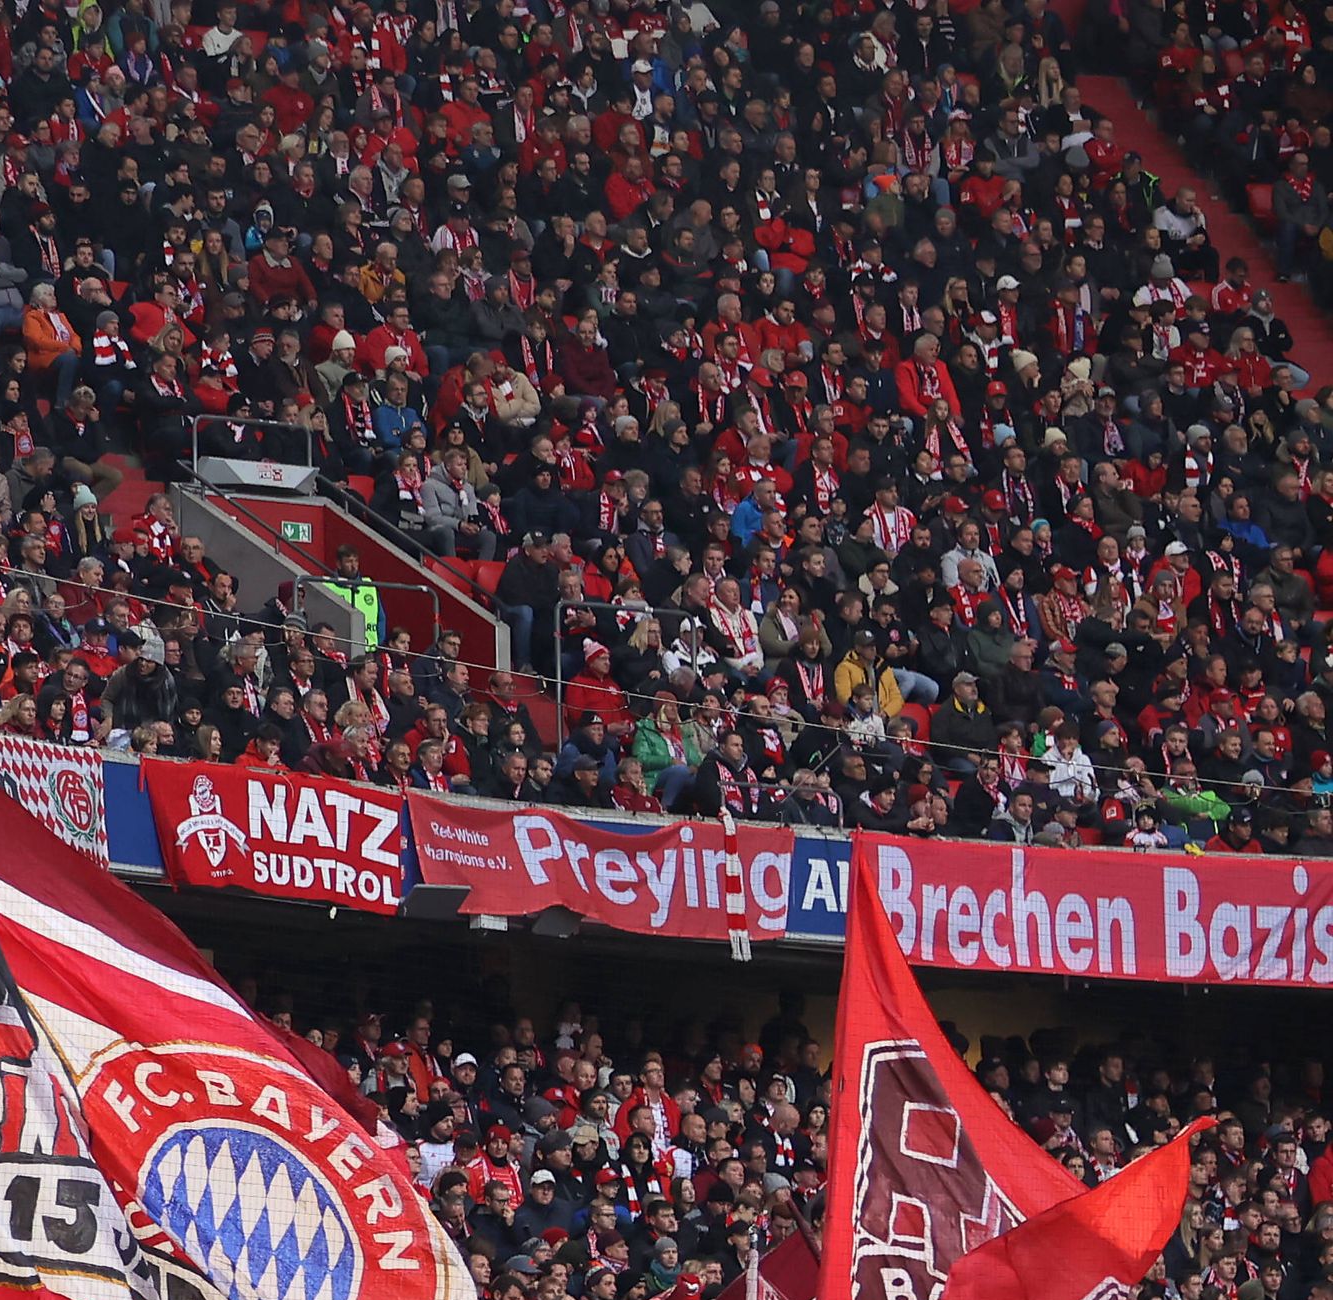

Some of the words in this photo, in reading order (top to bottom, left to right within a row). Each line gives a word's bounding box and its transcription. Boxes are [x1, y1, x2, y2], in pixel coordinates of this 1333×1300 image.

[246, 780, 401, 867] NATZ
[430, 821, 489, 847] Red-White
[487, 855, 513, 871] e.V.
[512, 814, 792, 929] Preying
[877, 845, 1135, 975] Brechen
[103, 1062, 195, 1132] F.C.
[195, 1070, 421, 1272] BAYERN
